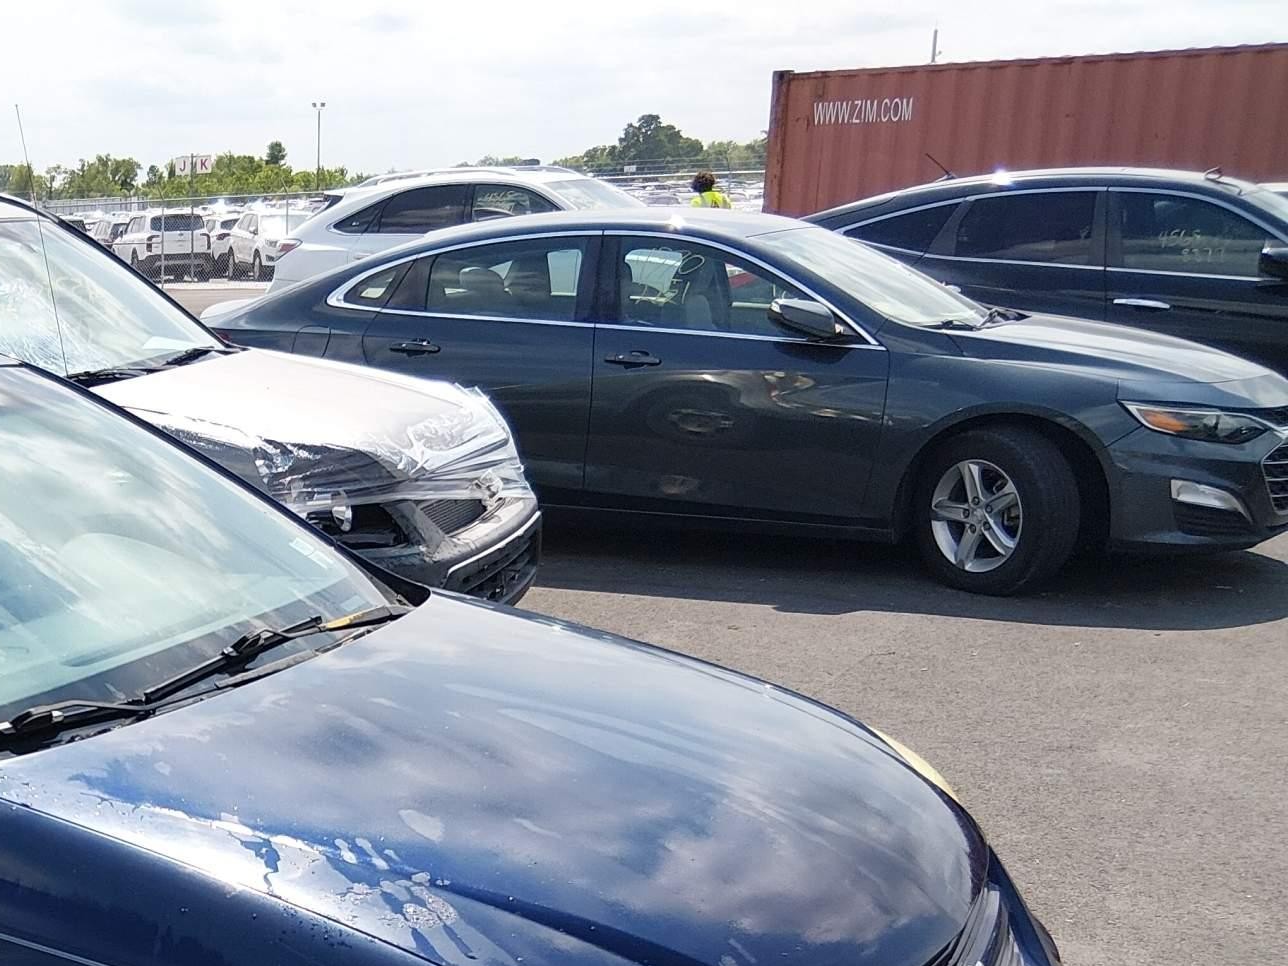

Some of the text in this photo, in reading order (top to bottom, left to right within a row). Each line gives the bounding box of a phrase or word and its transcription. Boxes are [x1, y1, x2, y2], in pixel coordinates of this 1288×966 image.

[813, 97, 913, 126] WWW.ZIM.COM
[179, 160, 186, 171] J
[200, 159, 208, 170] K
